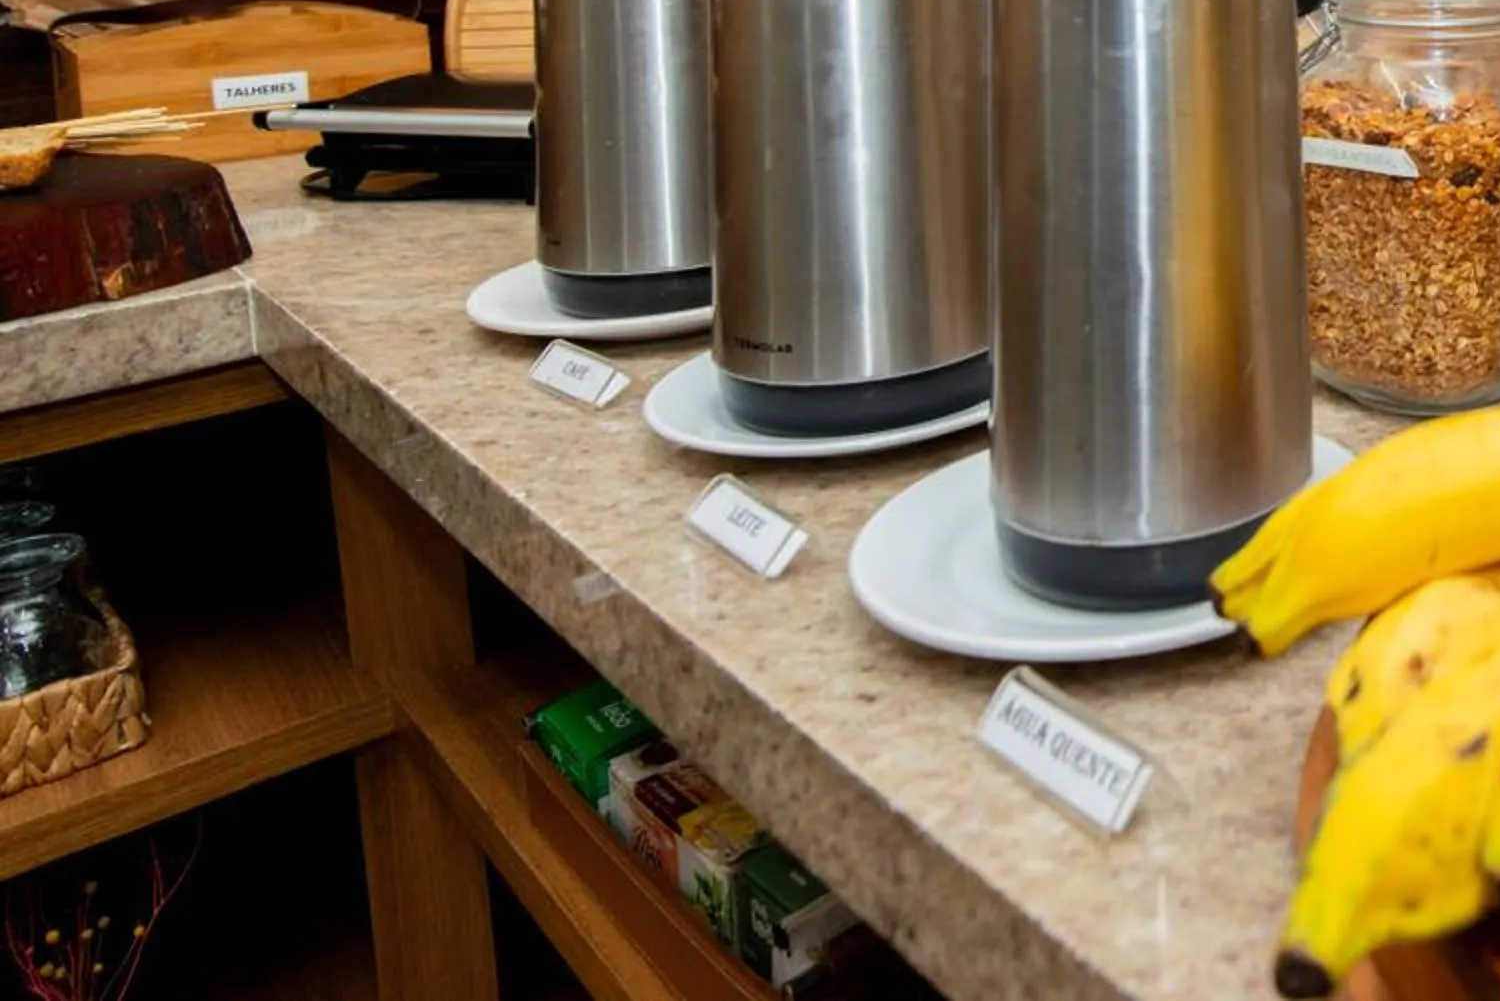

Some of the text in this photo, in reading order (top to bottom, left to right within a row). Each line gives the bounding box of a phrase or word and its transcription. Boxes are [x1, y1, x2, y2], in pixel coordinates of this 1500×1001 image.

[223, 81, 296, 98] TALHERES
[725, 502, 767, 538] LEITE
[1050, 730, 1133, 797] QUENTE
